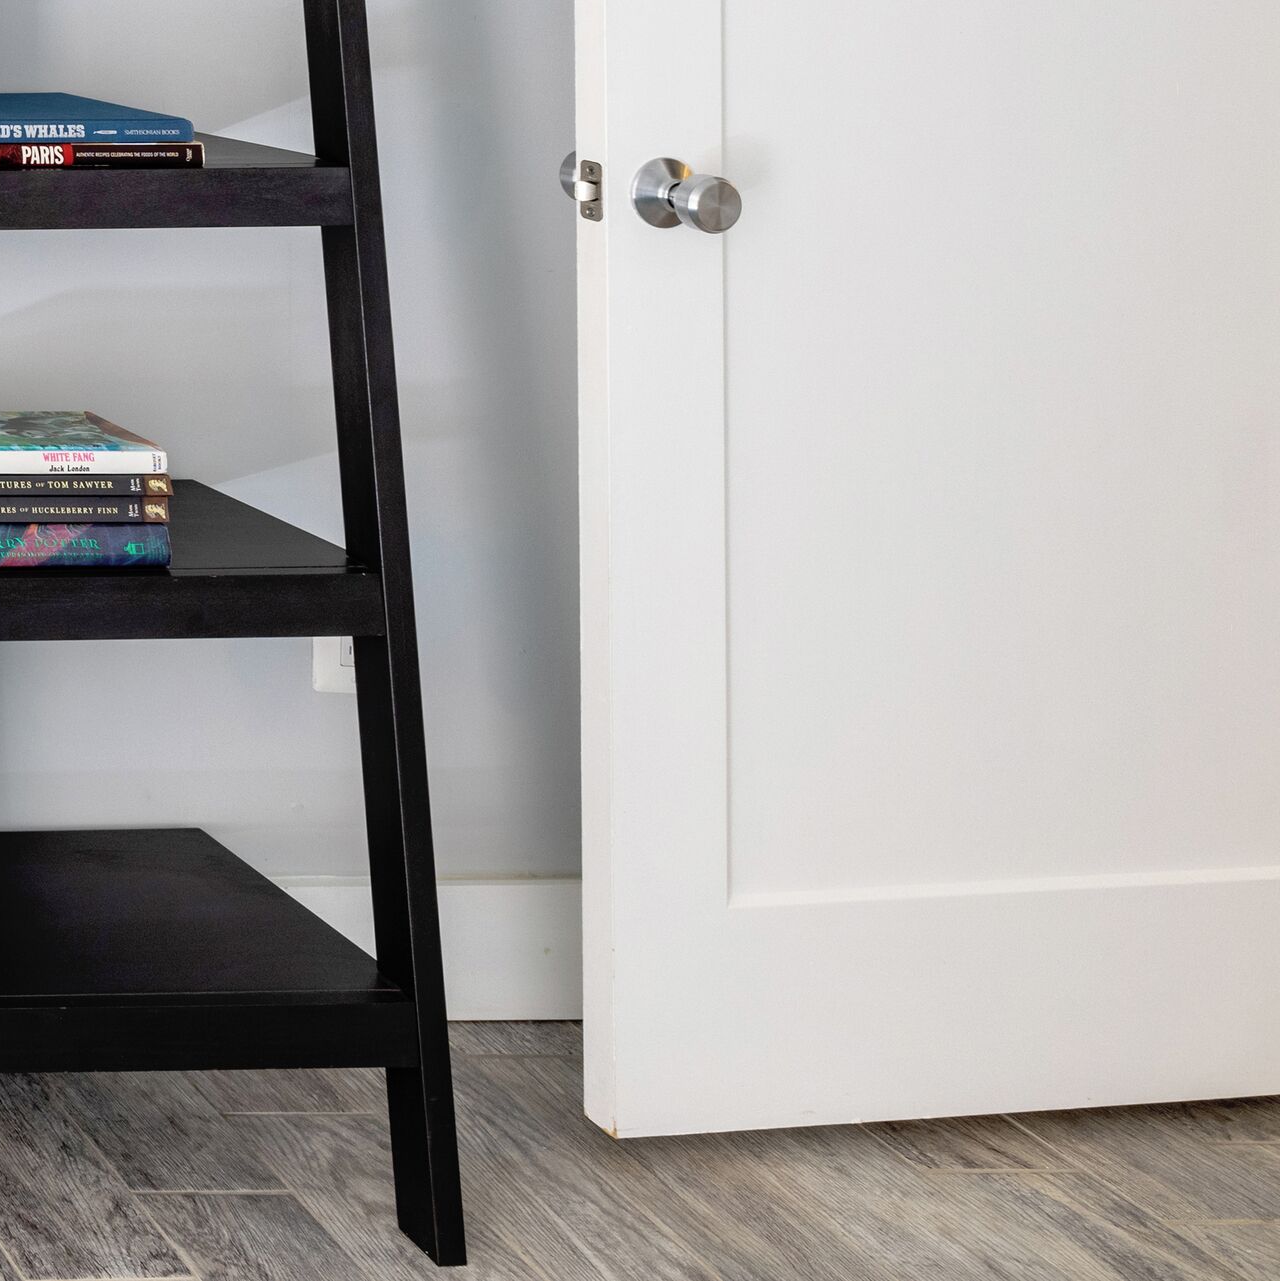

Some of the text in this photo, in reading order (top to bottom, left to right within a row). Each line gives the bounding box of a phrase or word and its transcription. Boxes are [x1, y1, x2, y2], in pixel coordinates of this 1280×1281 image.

[24, 124, 85, 138] WHALES
[21, 145, 64, 165] PARIS
[42, 452, 95, 463] WHITE FANG
[67, 464, 90, 472] London
[47, 481, 70, 489] TOM
[73, 481, 114, 489] SAWYER
[97, 506, 118, 514] FINN
[35, 538, 101, 549] POTTER
